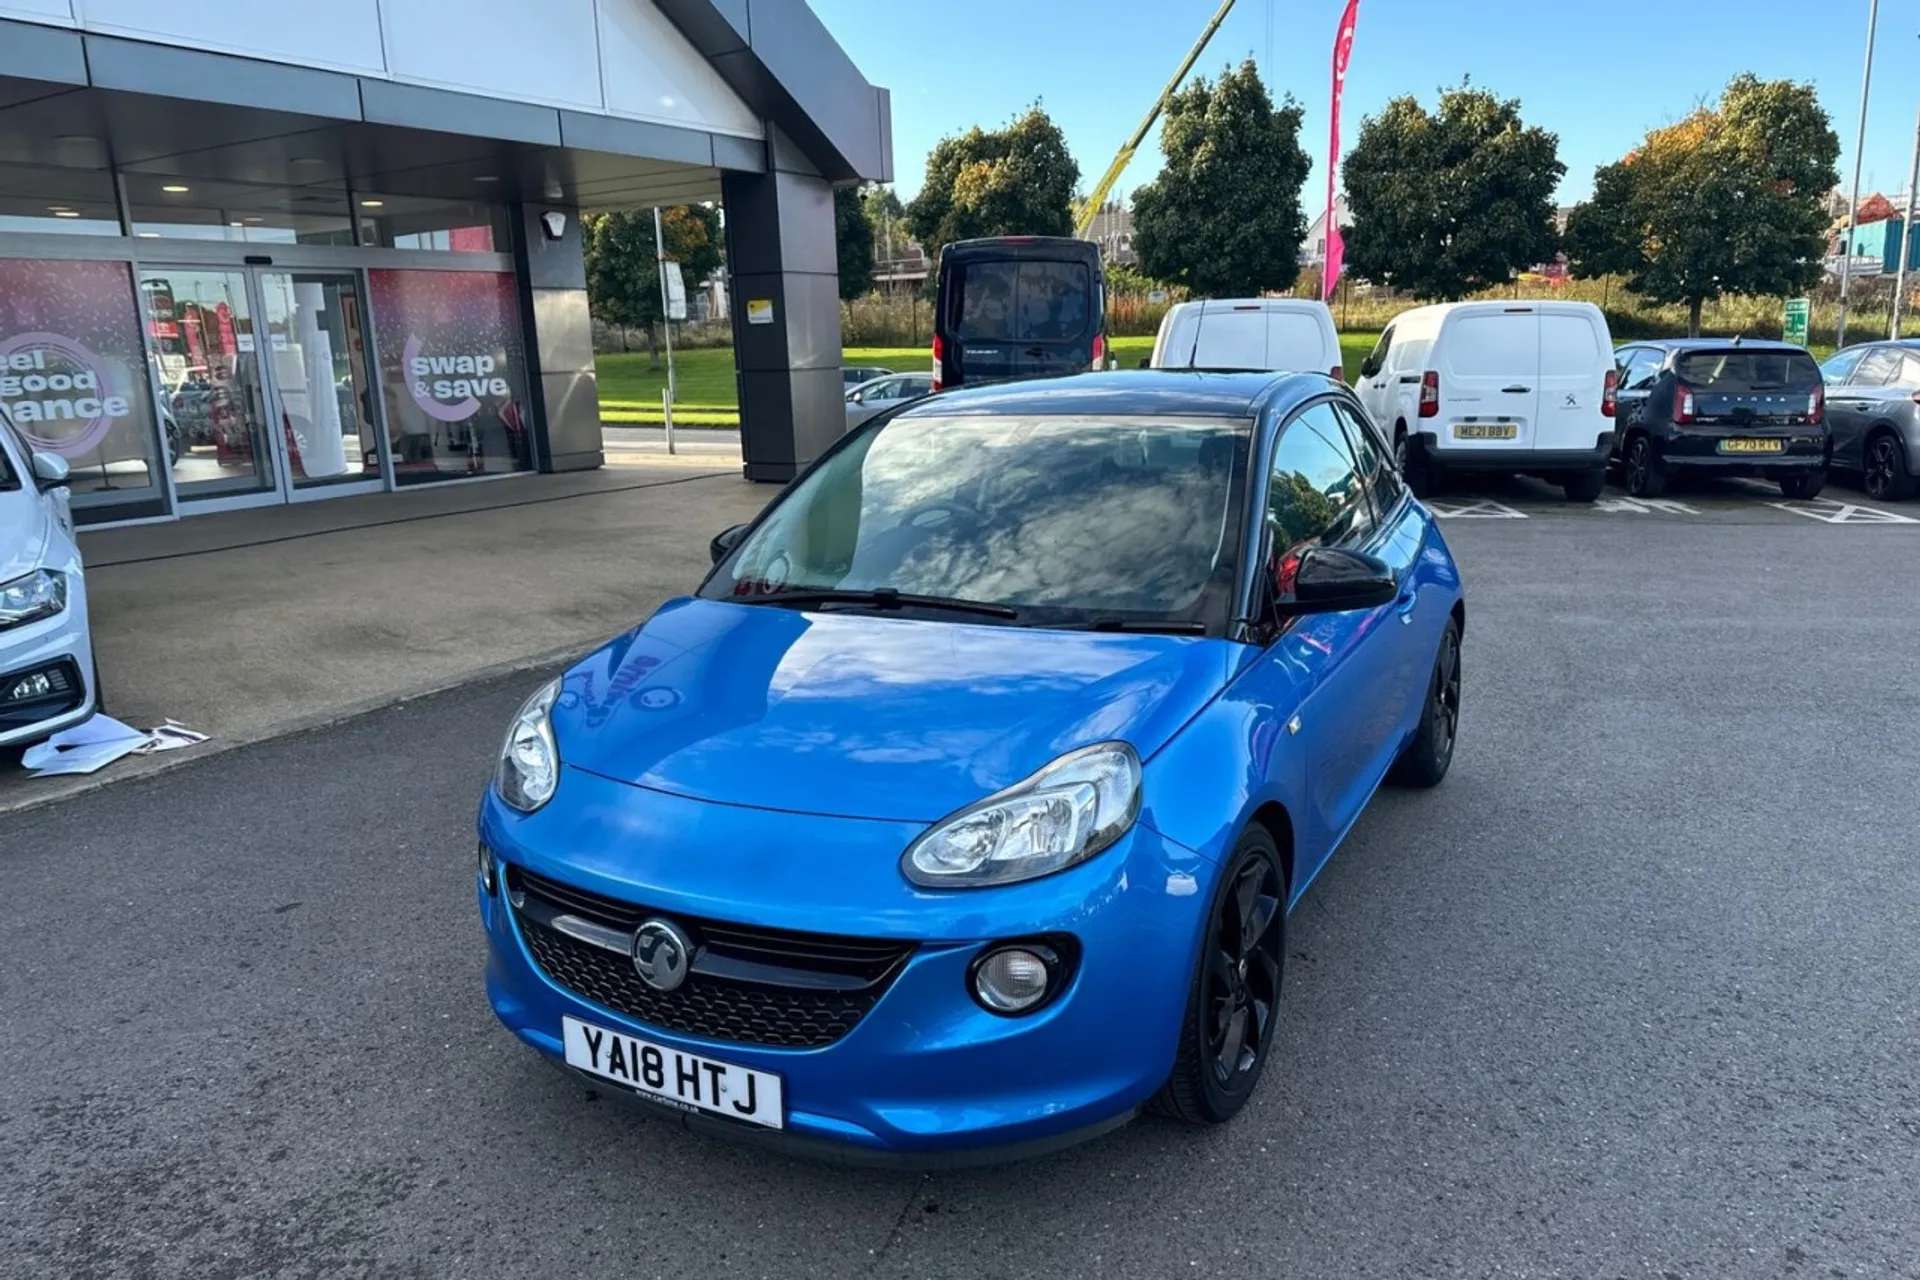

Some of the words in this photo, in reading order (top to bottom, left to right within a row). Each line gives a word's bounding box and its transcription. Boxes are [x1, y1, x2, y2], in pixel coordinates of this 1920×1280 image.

[410, 355, 496, 376] swap
[0, 371, 97, 396] good
[415, 381, 431, 398] &
[433, 377, 507, 399] save
[582, 1026, 664, 1089] YA18
